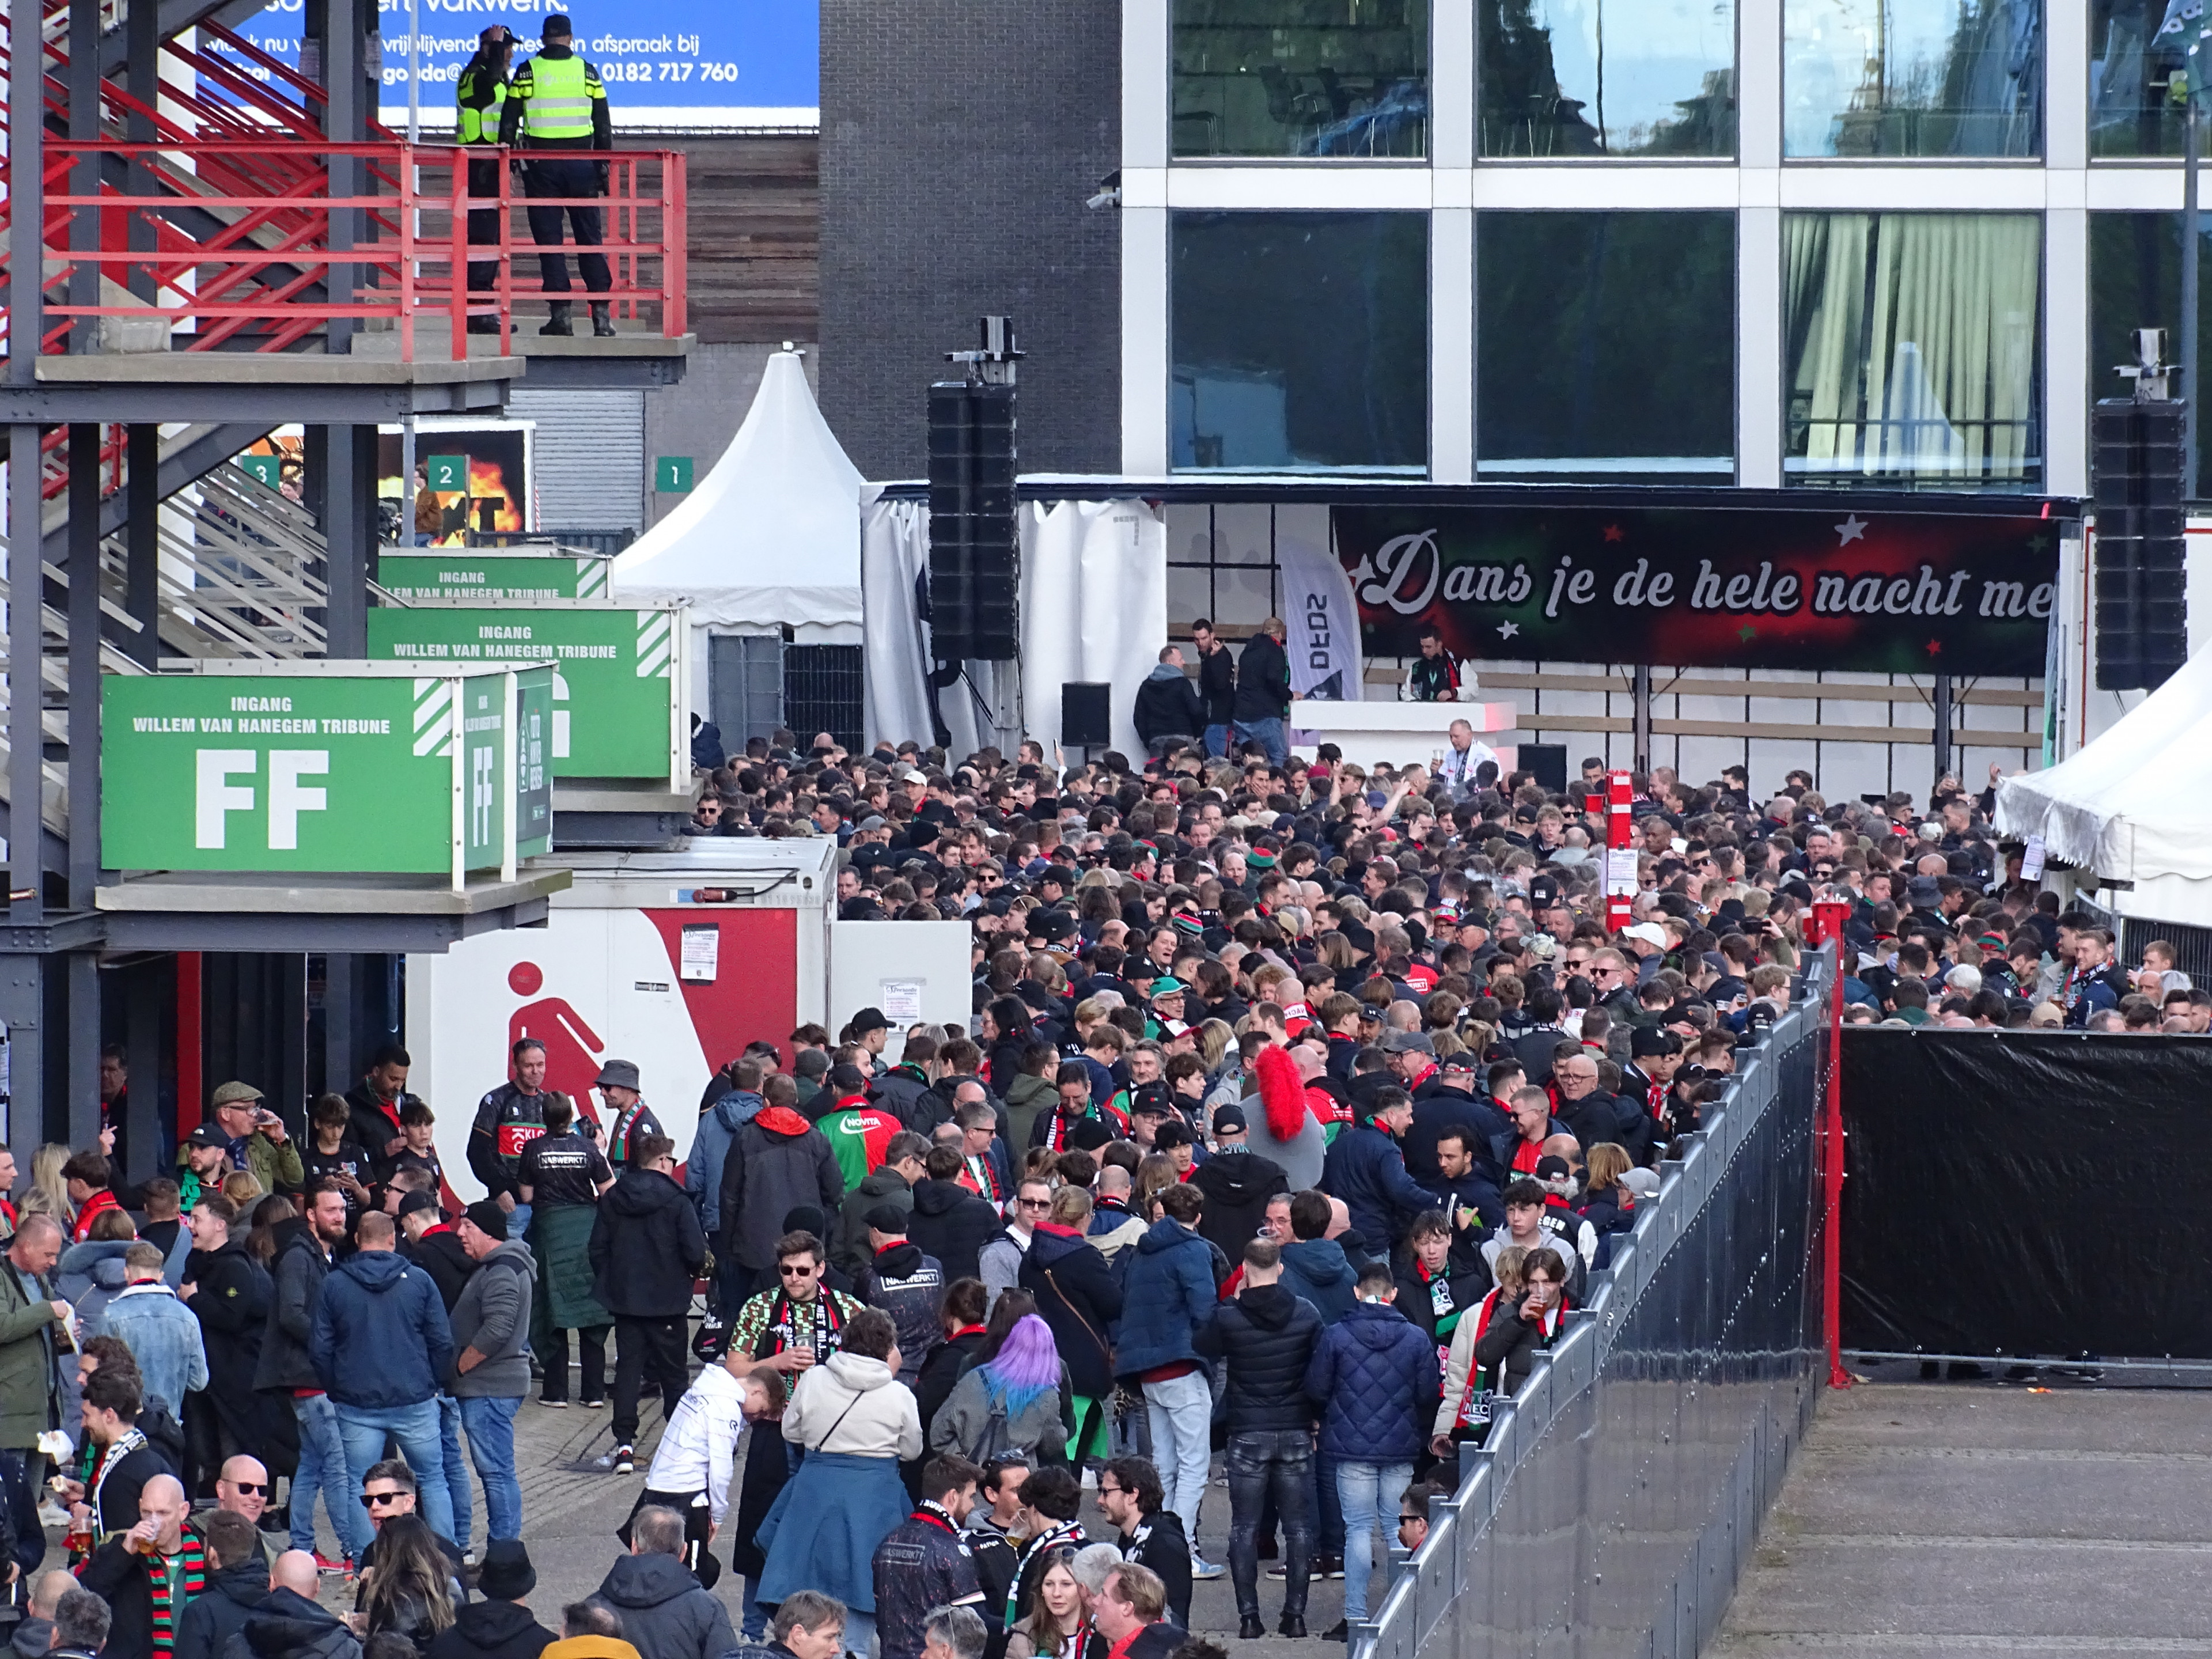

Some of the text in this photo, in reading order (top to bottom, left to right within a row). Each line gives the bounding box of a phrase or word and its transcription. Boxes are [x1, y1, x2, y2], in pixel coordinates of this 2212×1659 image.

[265, 39, 287, 52] nu
[382, 34, 479, 56] vrijlijvend
[592, 34, 672, 56] afspraak
[677, 35, 699, 56] bij
[602, 63, 652, 81] 0182
[659, 62, 694, 82] 717
[700, 63, 738, 82] 760
[256, 465, 267, 483] 3
[440, 465, 452, 484] 2
[672, 467, 679, 484] 1
[439, 571, 485, 584] INGANG
[1362, 528, 1532, 615] Dans
[1546, 555, 1596, 617] je
[1613, 558, 1675, 607] de
[1691, 559, 1798, 610] hele
[1815, 565, 1971, 615] nacht
[416, 588, 440, 598] VAN
[444, 588, 504, 598] HANEGEM
[507, 588, 559, 599] TRIBUNE
[479, 626, 532, 639] INGANG
[394, 643, 616, 658] WILLEM VAN HANEGEM TRIBUNE
[231, 696, 292, 712] INGANG
[133, 718, 390, 734] WILLEM VAN HANEGEM TRIBUNE
[195, 749, 329, 850] FF
[473, 746, 493, 848] FF
[847, 1117, 881, 1127] NOVITA
[885, 1273, 935, 1286] NAWERKT
[816, 1304, 826, 1327] MET
[1465, 1402, 1488, 1415] NEC
